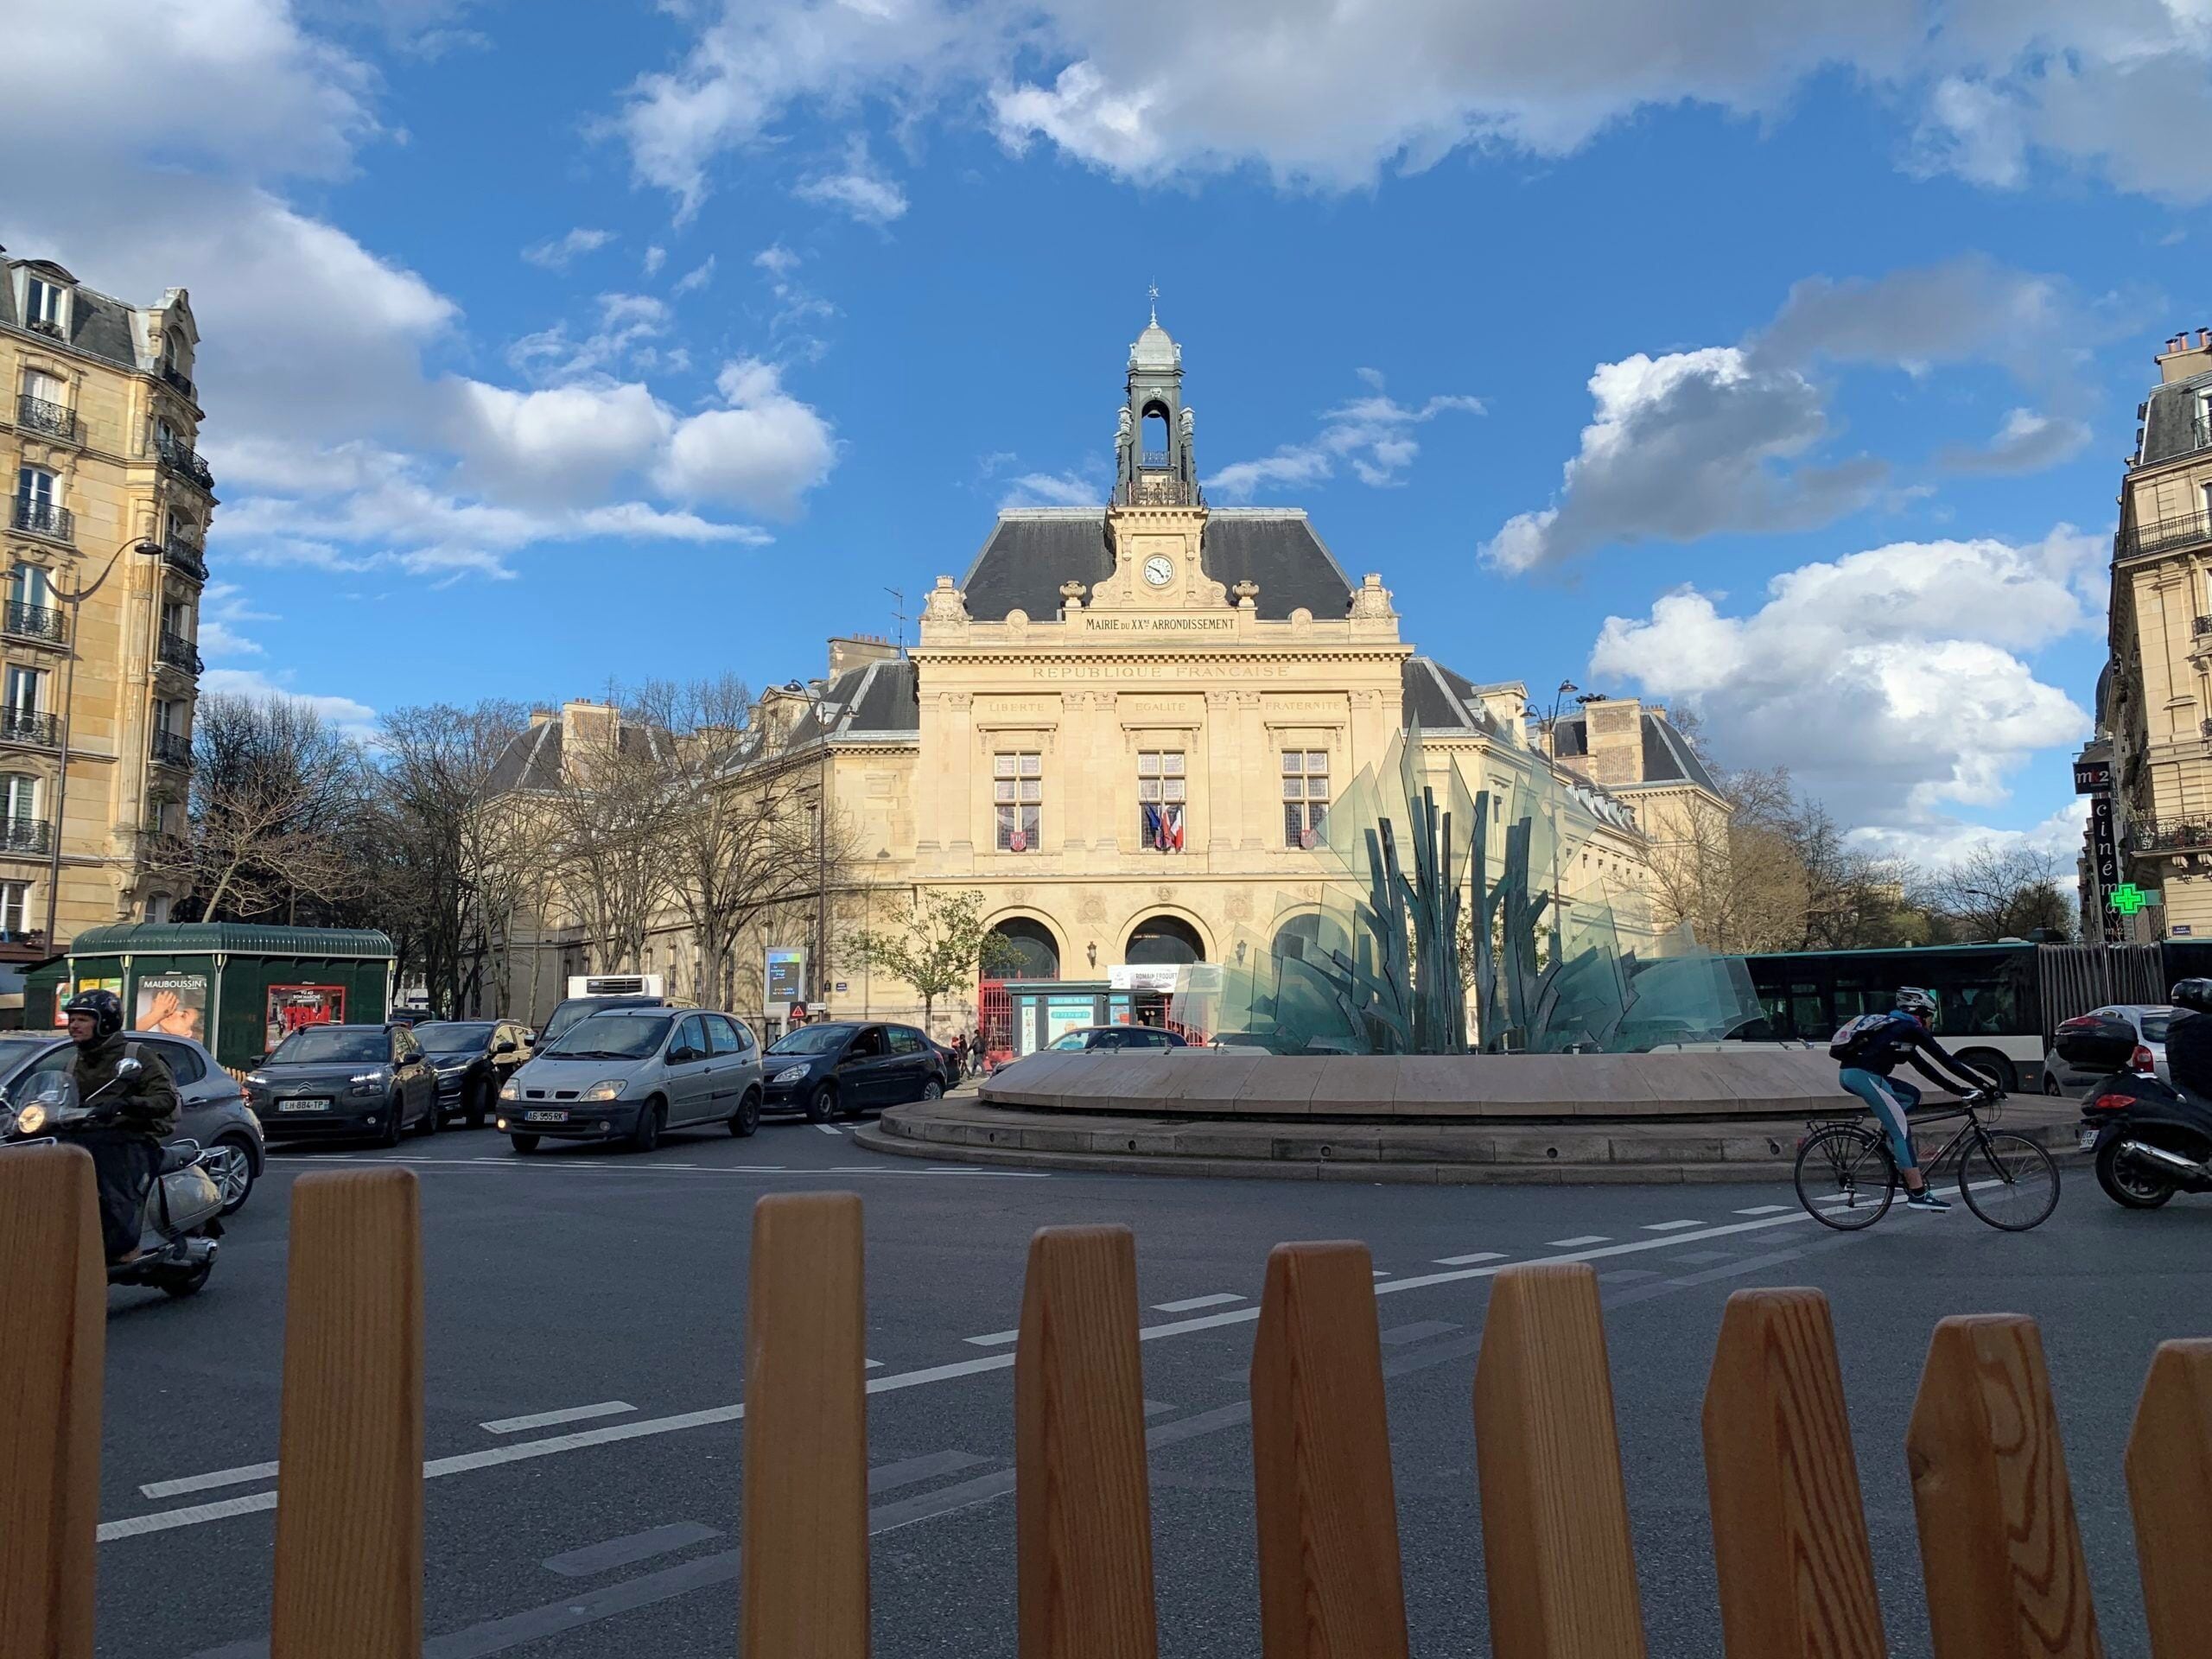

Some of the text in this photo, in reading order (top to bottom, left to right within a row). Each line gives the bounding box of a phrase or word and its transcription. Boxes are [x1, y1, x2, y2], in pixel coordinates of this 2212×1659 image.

[1086, 619, 1120, 630] MAIRIE
[1152, 619, 1235, 630] ARRONDISSEMENT
[2076, 767, 2109, 785] mk2
